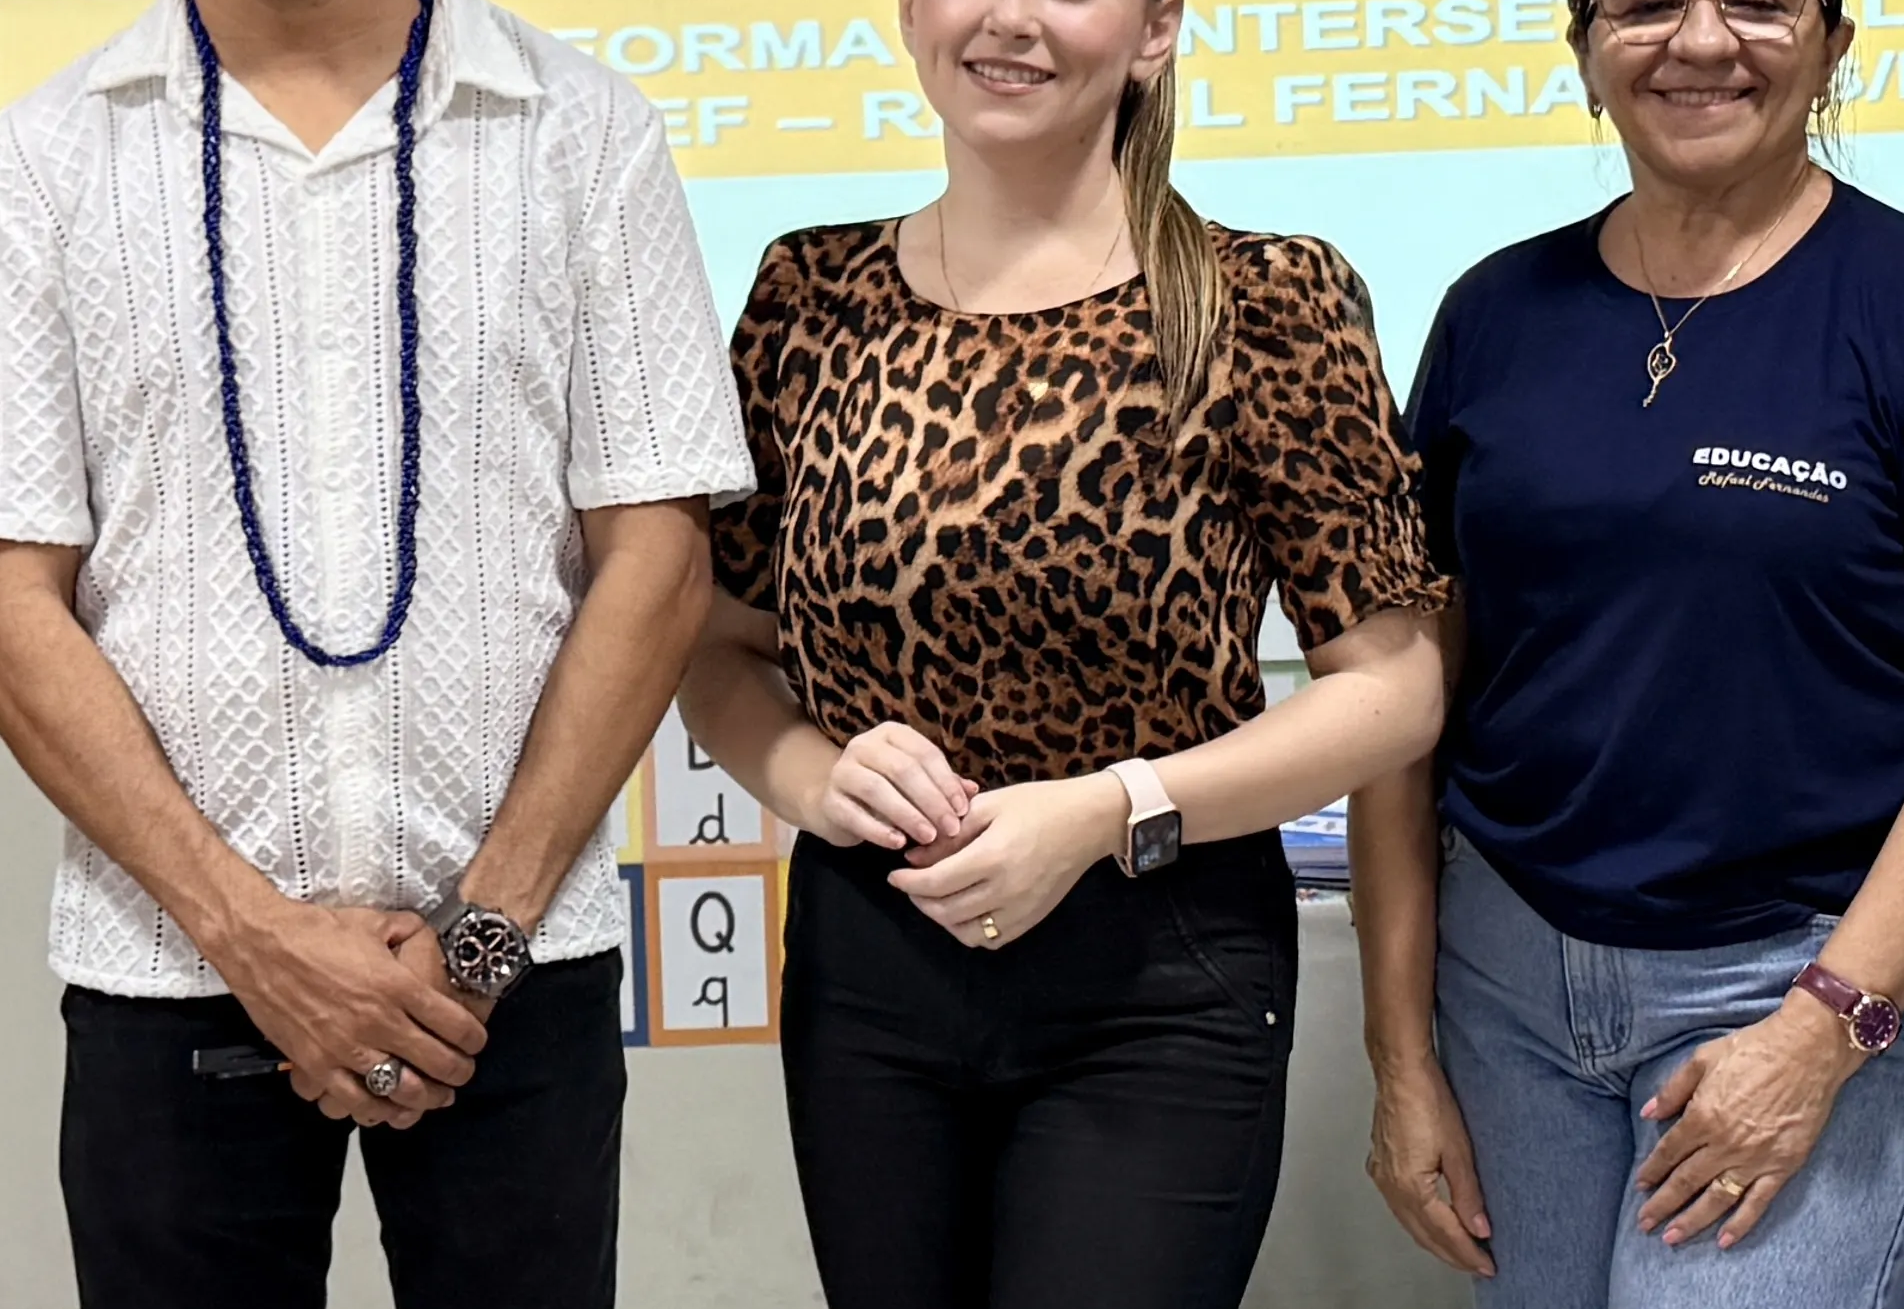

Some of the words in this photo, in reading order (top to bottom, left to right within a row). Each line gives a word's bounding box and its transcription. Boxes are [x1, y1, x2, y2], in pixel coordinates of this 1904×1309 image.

[549, 17, 899, 75] ORMA
[1692, 447, 1848, 490] EDUCAÇÃO
[1698, 471, 1753, 488] Rafael
[1752, 476, 1829, 503] Fernandes
[689, 793, 730, 844] d
[690, 891, 736, 953] Q
[692, 976, 728, 1028] q
